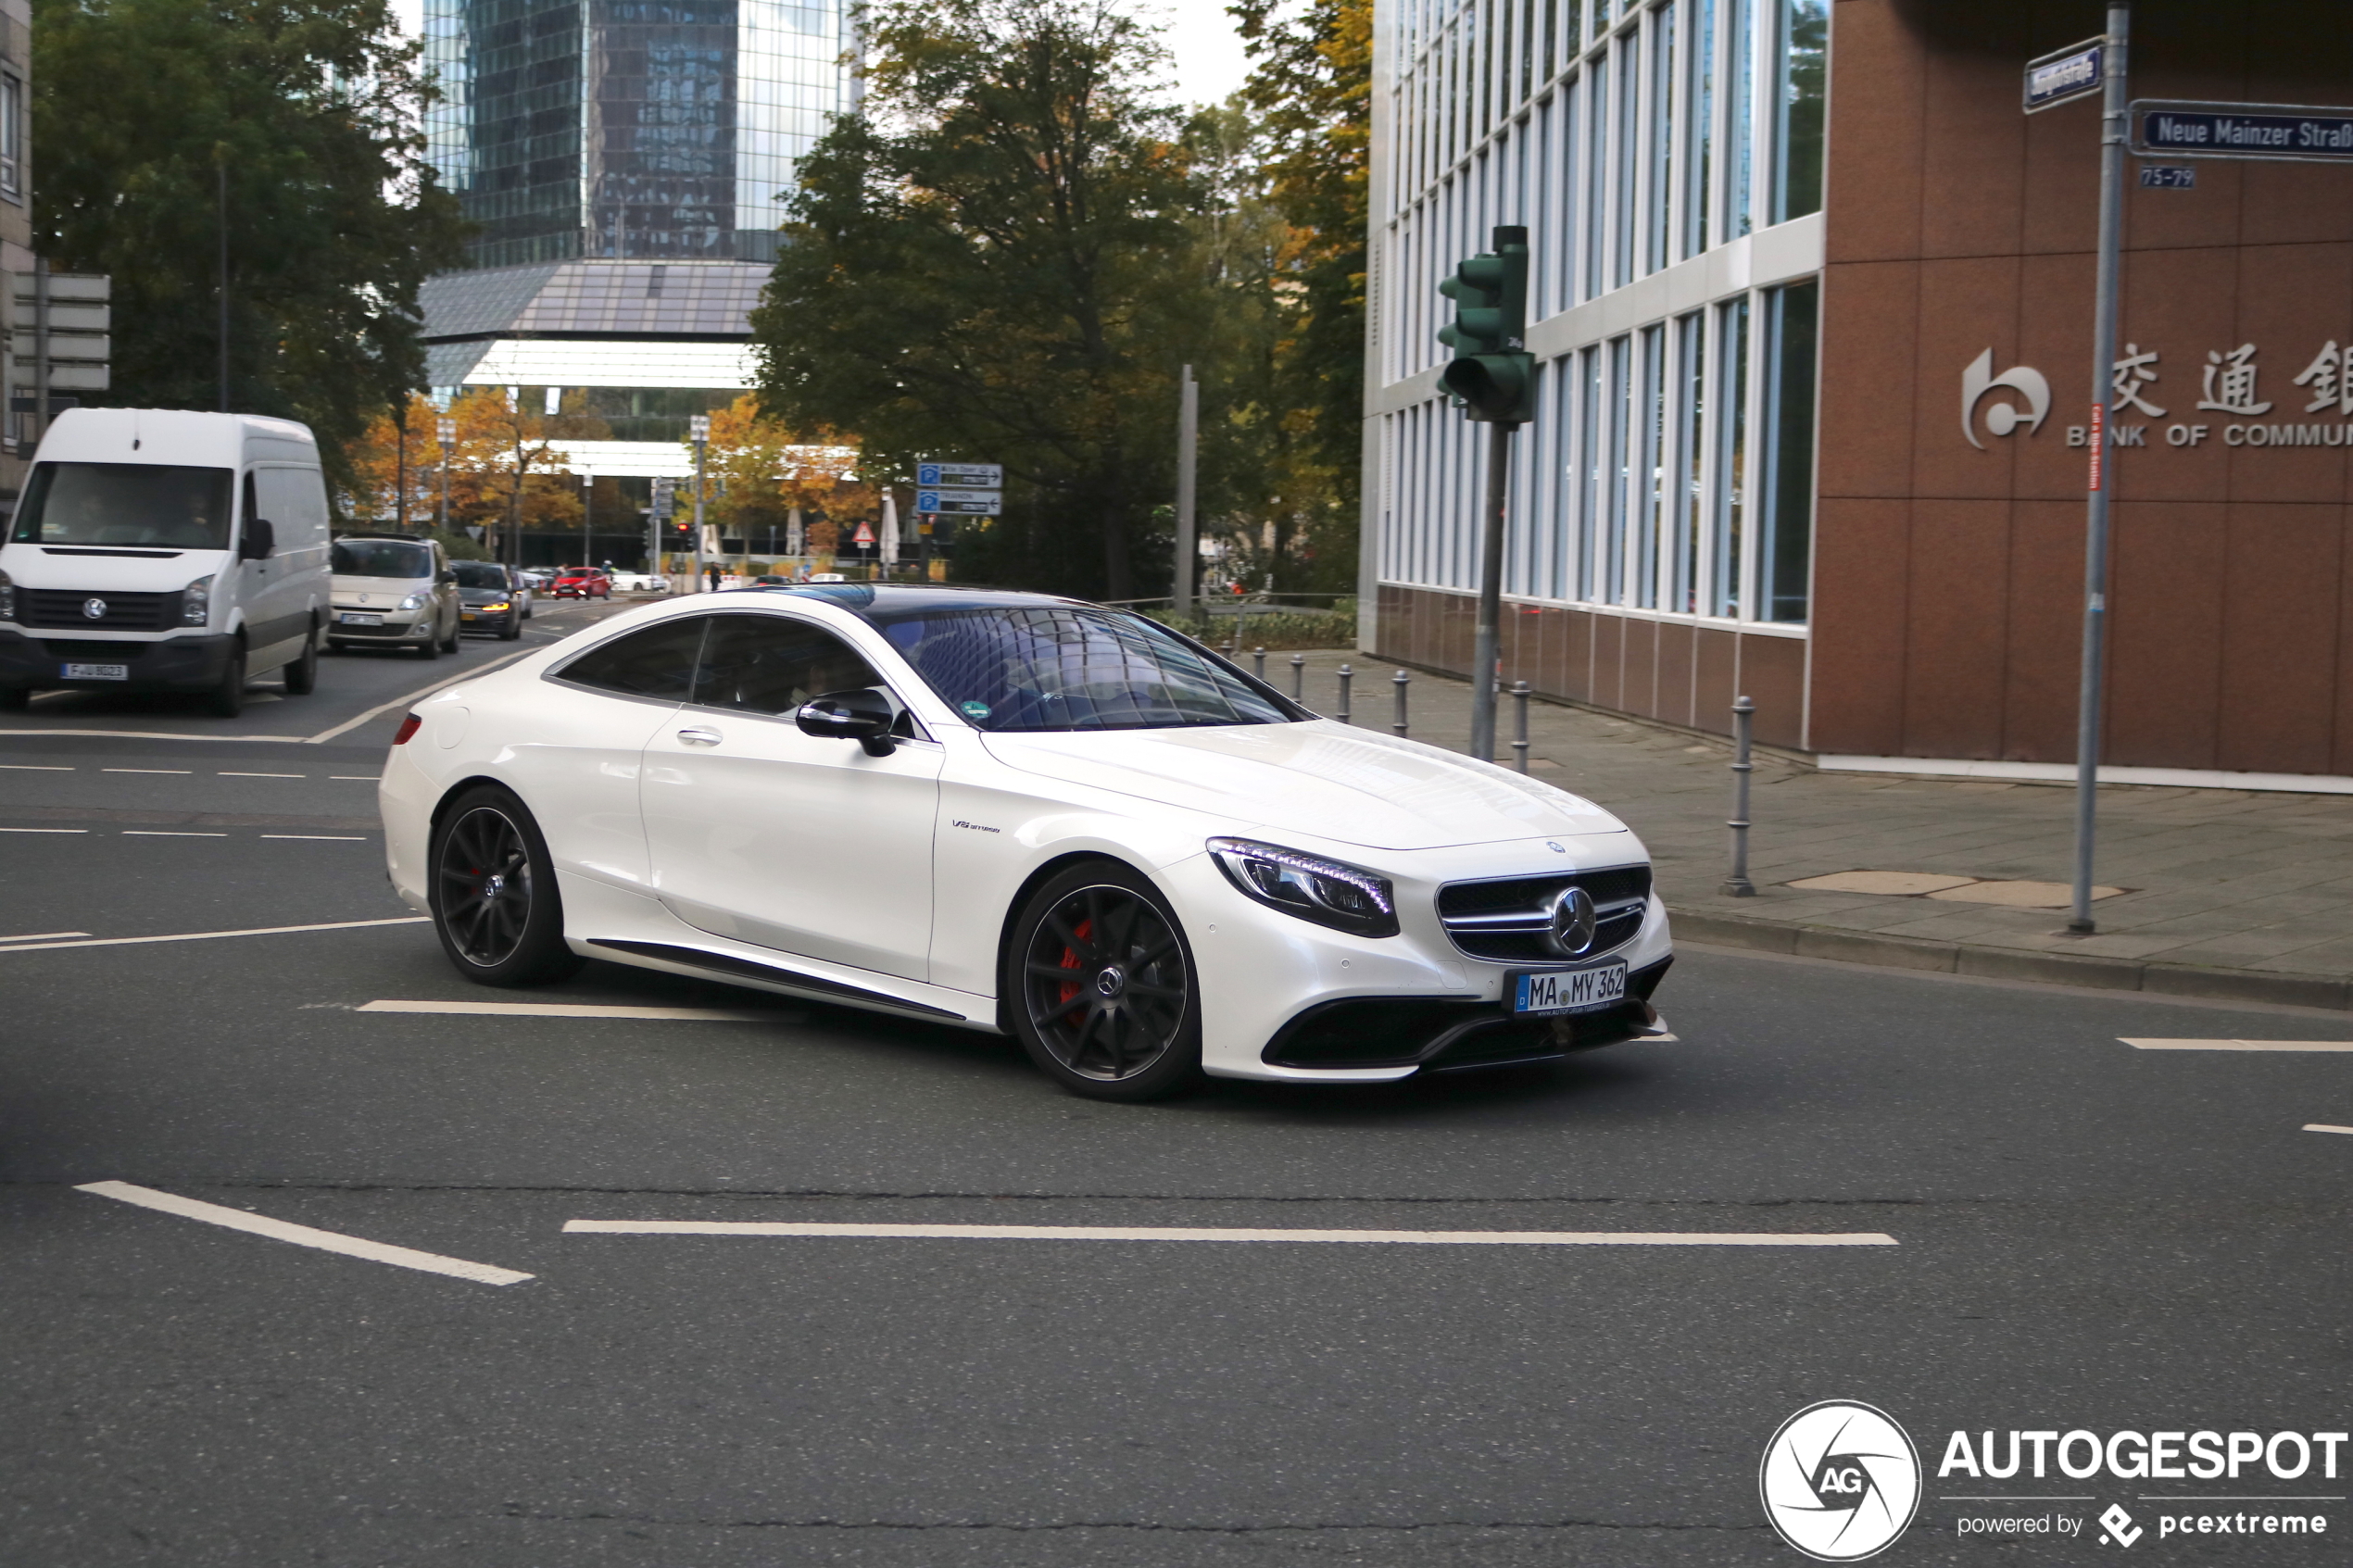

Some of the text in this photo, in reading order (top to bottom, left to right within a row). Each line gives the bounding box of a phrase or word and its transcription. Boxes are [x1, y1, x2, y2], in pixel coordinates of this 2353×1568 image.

[2158, 117, 2208, 143] Neue
[2215, 119, 2292, 146] Mainzer
[2142, 169, 2194, 185] 75-79
[2067, 426, 2145, 446] BNK
[2166, 425, 2208, 446] OF
[952, 820, 970, 828] V8
[1529, 976, 1556, 1007] MA
[1572, 972, 1594, 1002] MY
[1598, 967, 1624, 998] 362
